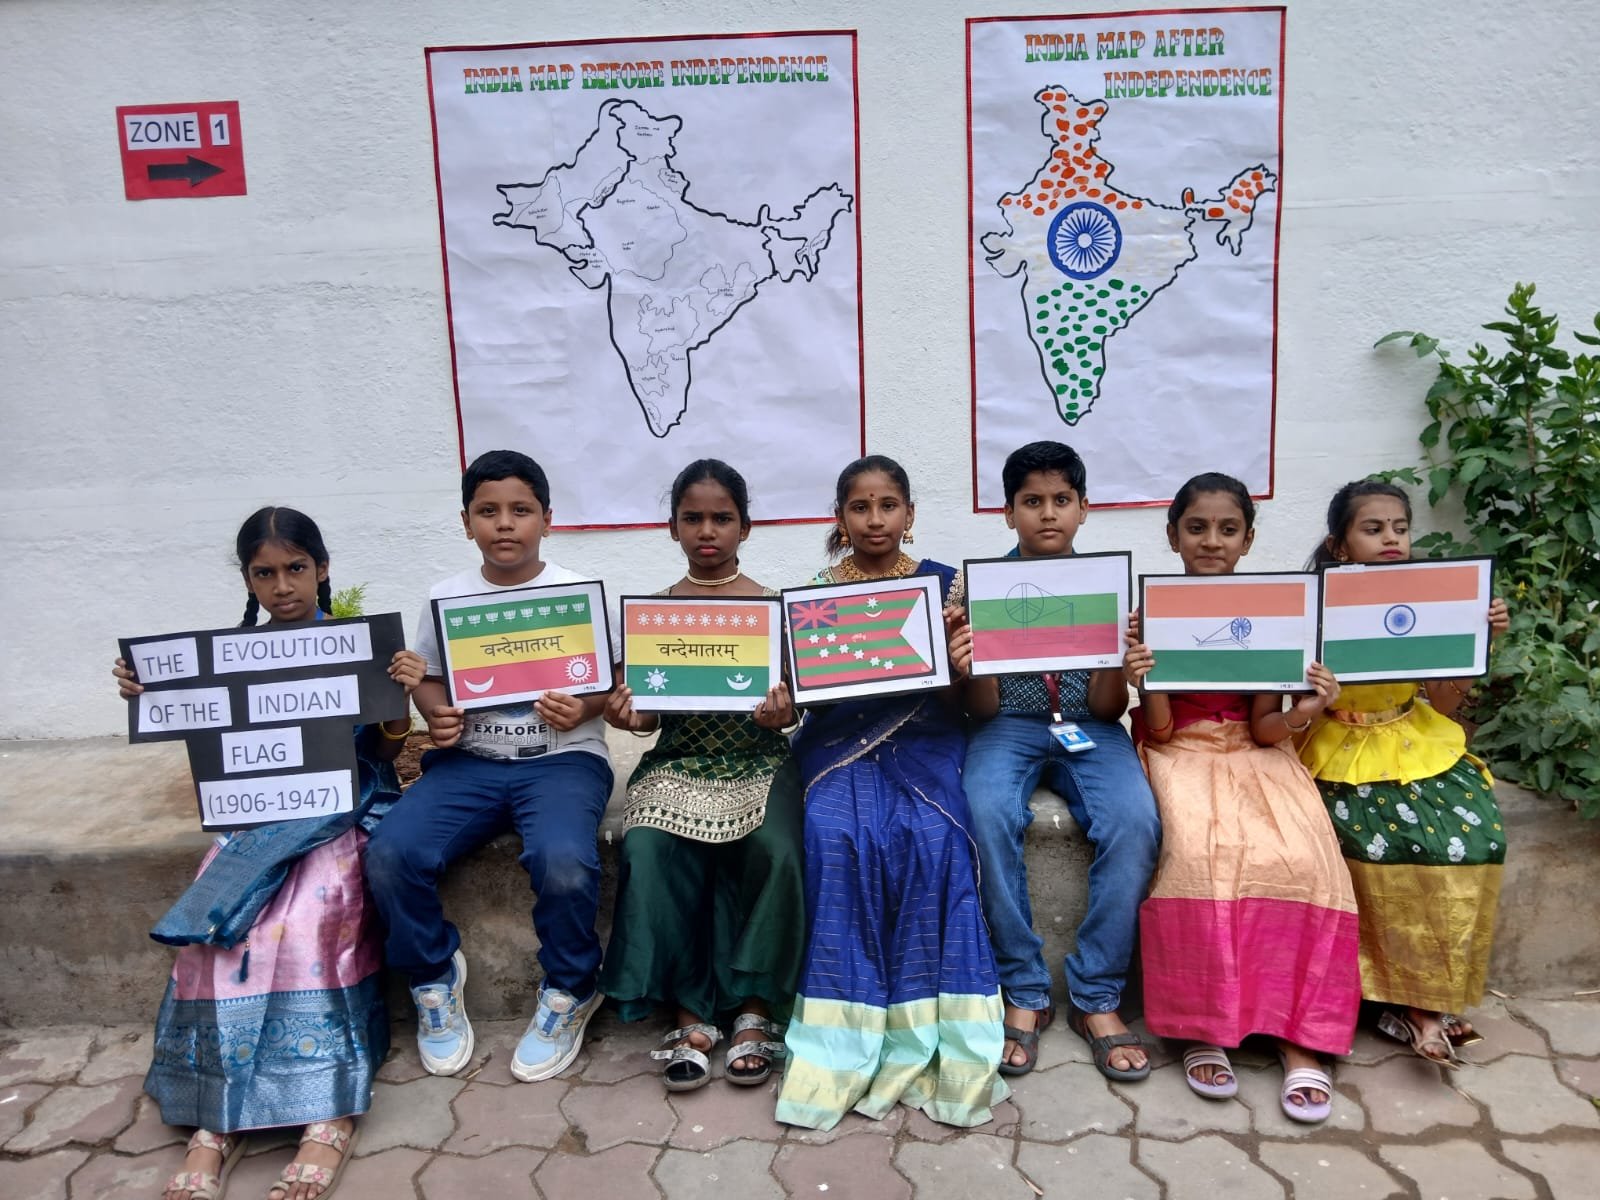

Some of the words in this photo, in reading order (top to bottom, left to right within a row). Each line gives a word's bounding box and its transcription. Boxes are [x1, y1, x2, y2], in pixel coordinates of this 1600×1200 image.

[1024, 33, 1090, 63] INDIA
[1096, 30, 1146, 60] MAP
[1153, 27, 1225, 58] AFTER
[463, 67, 523, 94] INDIA
[529, 63, 576, 91] MAP
[580, 60, 666, 90] BEFORE
[670, 55, 830, 87] INDEPENDENCE
[1103, 68, 1272, 98] INDEPENDENCE
[129, 121, 196, 143] ZONE
[214, 119, 225, 140] 1
[142, 653, 186, 677] THE
[222, 635, 357, 663] EVOLUTION
[479, 634, 565, 657] वन्देमातरम्
[655, 638, 740, 663] वन्देमातरम्
[149, 704, 175, 725] OF
[180, 701, 221, 722] THE
[257, 689, 342, 715] INDIAN
[474, 723, 548, 735] EXPLORE
[231, 742, 287, 766] FLAG
[208, 785, 341, 818] (1906-1947)
